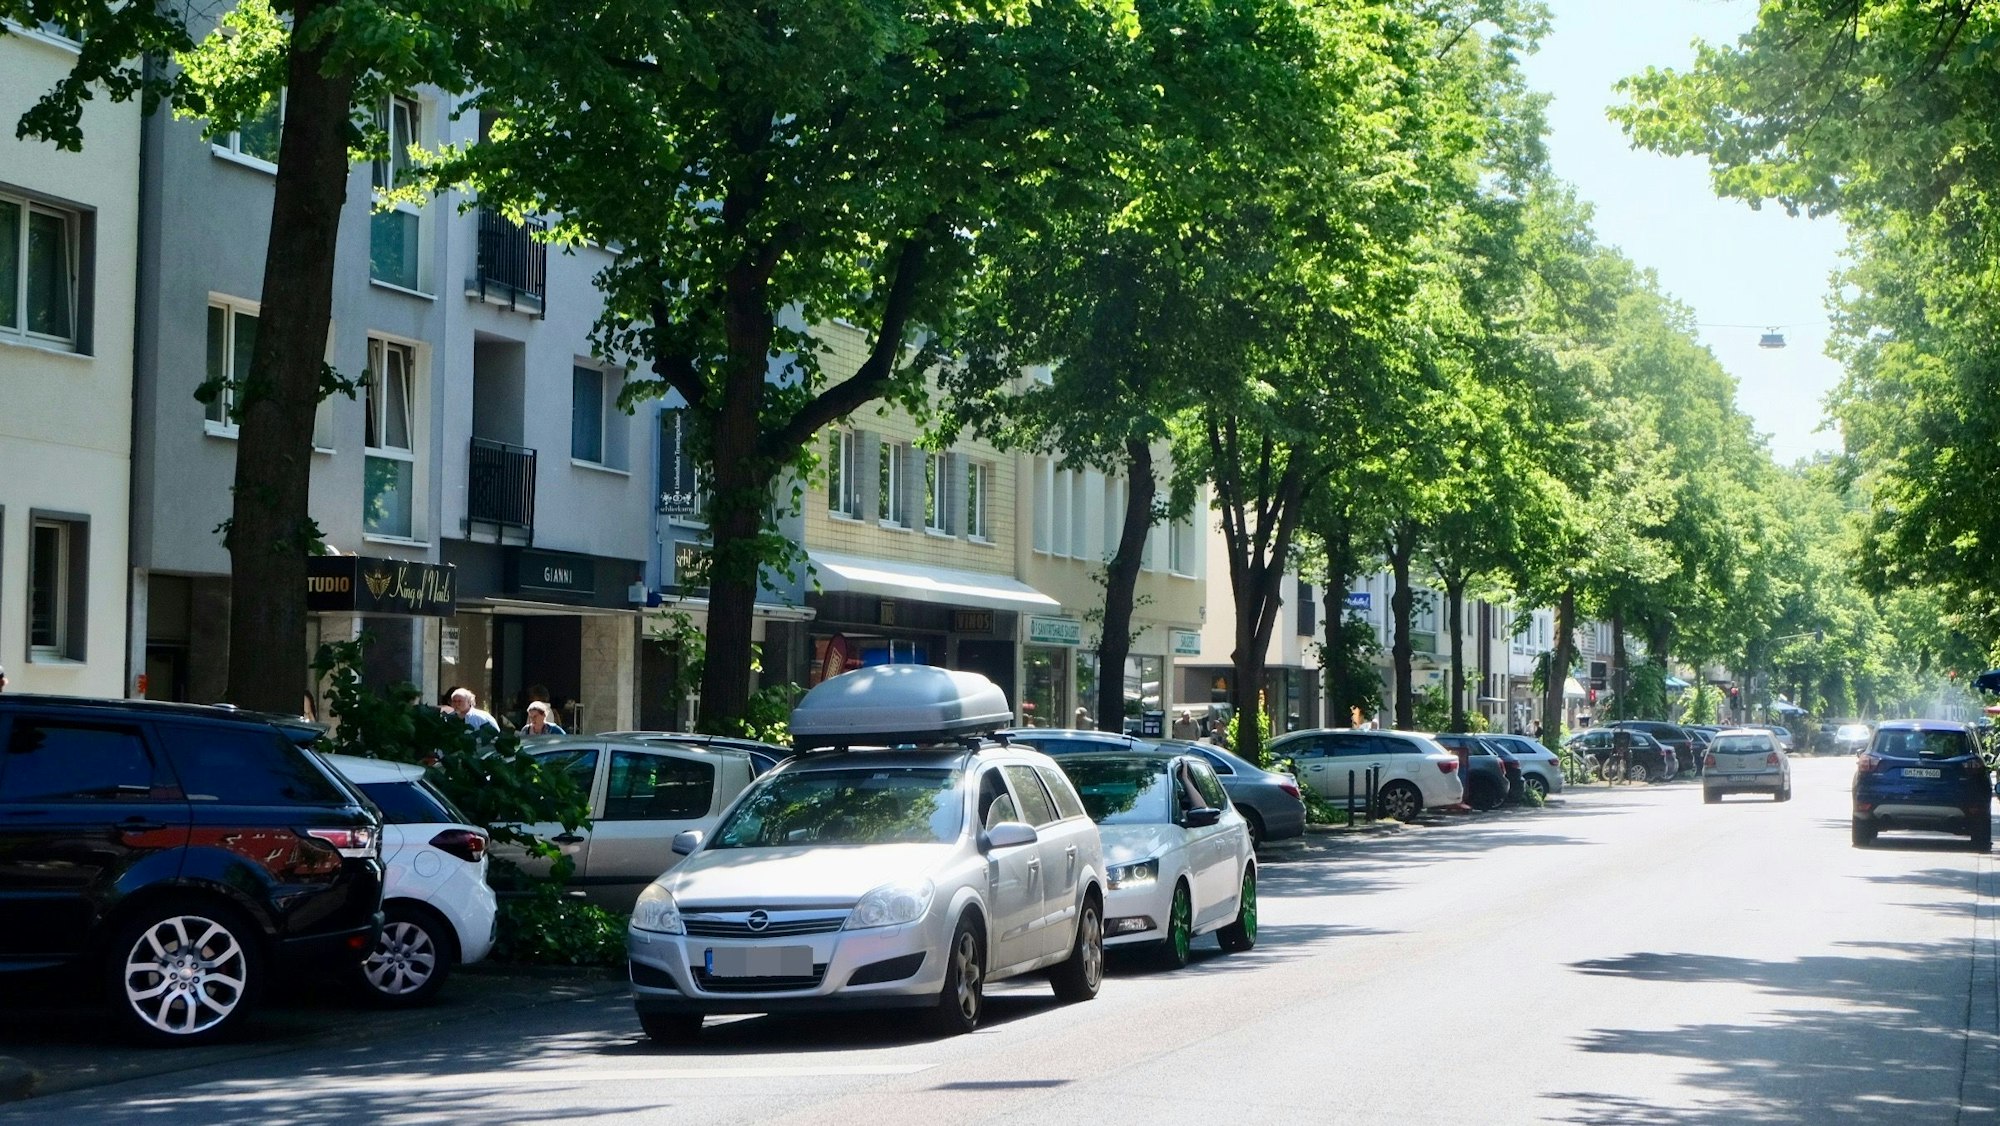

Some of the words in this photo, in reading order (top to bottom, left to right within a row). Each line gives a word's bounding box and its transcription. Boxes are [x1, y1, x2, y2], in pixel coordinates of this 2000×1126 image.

[544, 566, 572, 584] GIANNI
[307, 576, 350, 593] TUDIO
[389, 566, 416, 609] King
[416, 569, 428, 609] of
[428, 569, 450, 603] Nails
